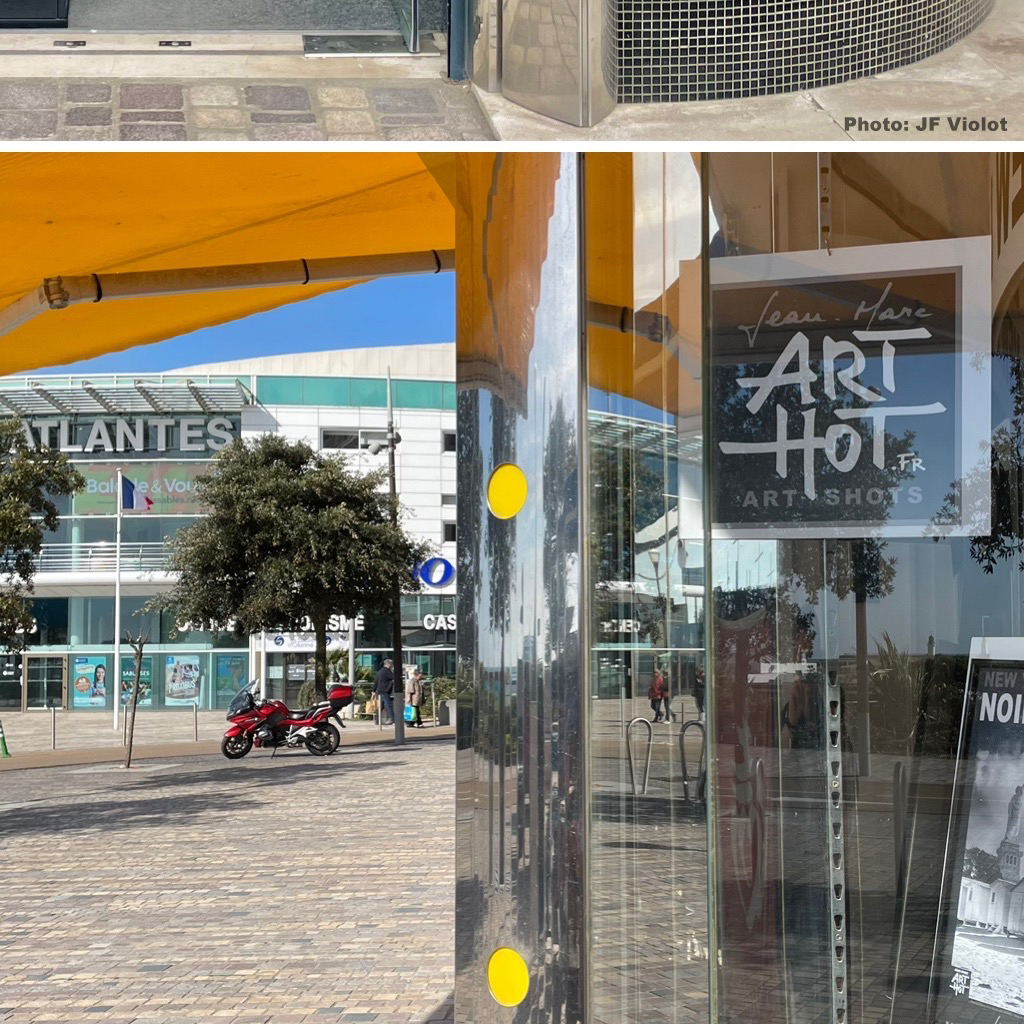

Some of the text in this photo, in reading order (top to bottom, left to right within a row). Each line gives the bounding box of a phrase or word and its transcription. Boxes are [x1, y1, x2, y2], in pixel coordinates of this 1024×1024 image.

[736, 327, 932, 415] ART
[151, 479, 162, 493] &
[742, 485, 924, 508] ART SHOTS
[423, 613, 456, 630] CAS
[984, 671, 1017, 688] NEW
[979, 692, 1024, 725] NOI
[951, 972, 970, 984] ART
